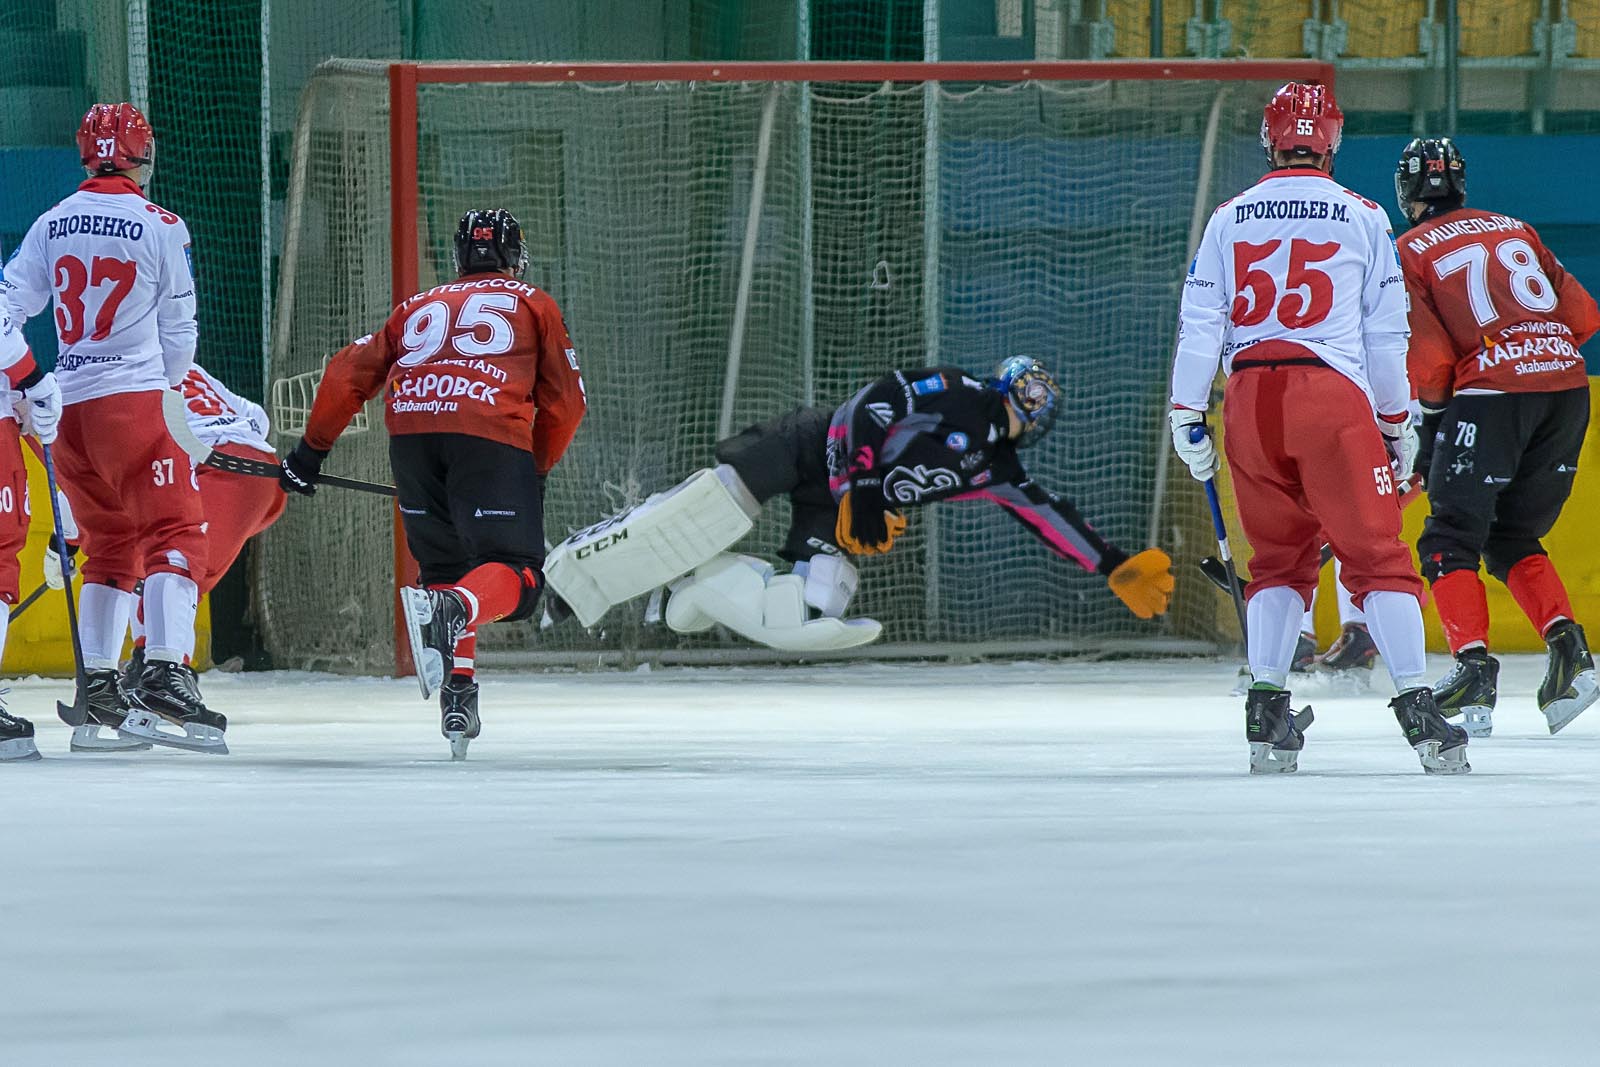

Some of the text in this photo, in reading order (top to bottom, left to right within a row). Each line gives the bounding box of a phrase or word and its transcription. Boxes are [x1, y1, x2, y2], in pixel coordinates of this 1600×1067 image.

[1296, 118, 1314, 136] 55
[96, 138, 116, 158] 37
[1425, 159, 1445, 173] 78
[1235, 199, 1350, 224] ПРОКОПЬЕВ М.
[48, 214, 144, 241] ВДОВЕНКО
[473, 227, 493, 240] 95
[1230, 237, 1342, 330] 55
[1432, 236, 1559, 328] 78
[54, 254, 138, 345] 37
[396, 291, 518, 368] 95
[392, 399, 458, 415] skabandy.ru
[1454, 420, 1477, 448] 78
[151, 458, 174, 487] 37
[1373, 466, 1393, 496] 55
[576, 527, 629, 560] CCM
